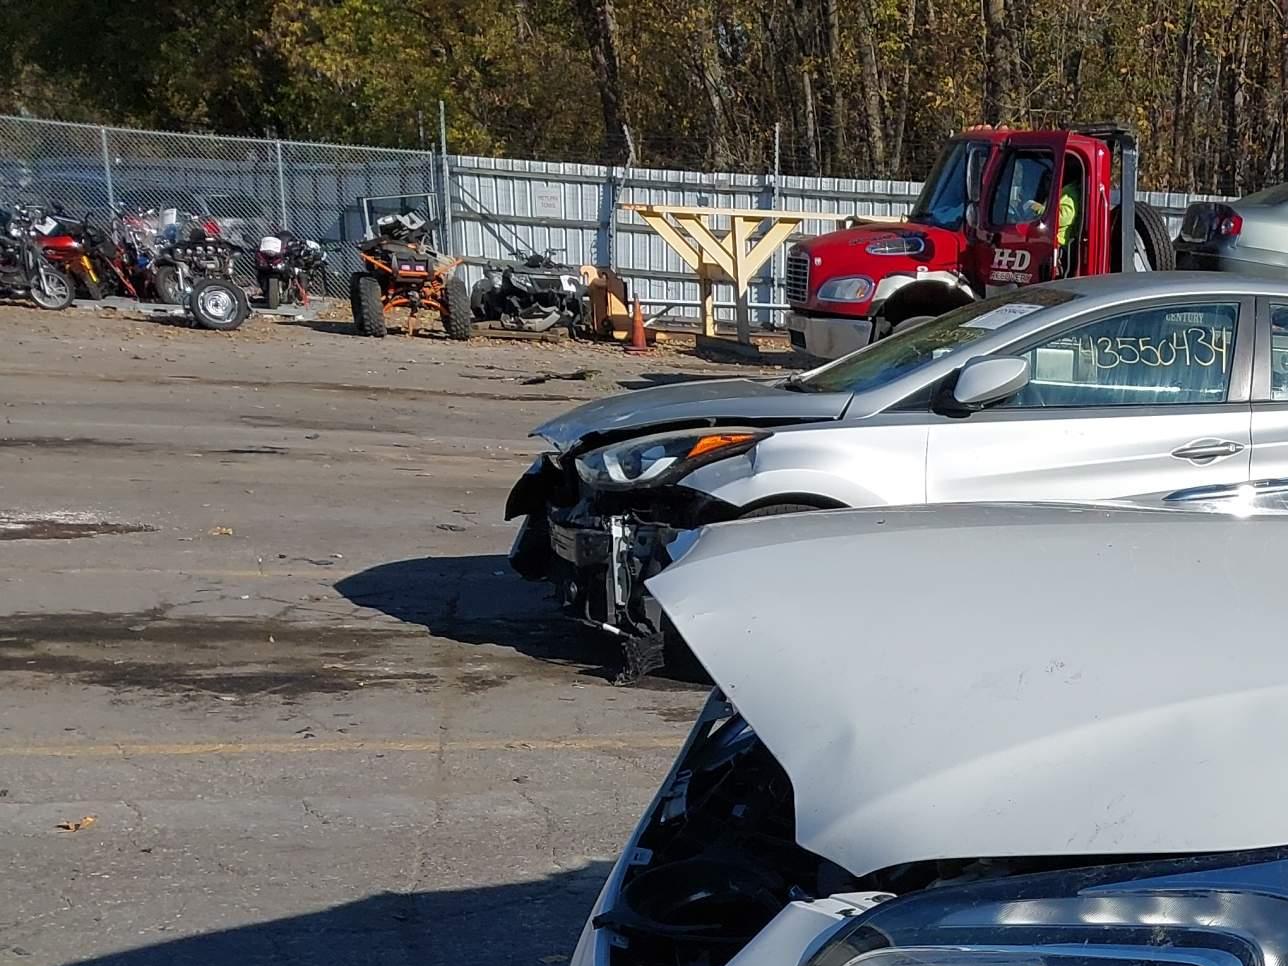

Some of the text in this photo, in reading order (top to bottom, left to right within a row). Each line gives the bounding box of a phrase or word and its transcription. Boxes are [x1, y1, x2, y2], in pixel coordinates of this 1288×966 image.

[991, 248, 1031, 271] H-D
[990, 271, 1033, 283] RECOVERY
[1166, 312, 1204, 324] CENTURY
[1078, 326, 1227, 374] 43550434
